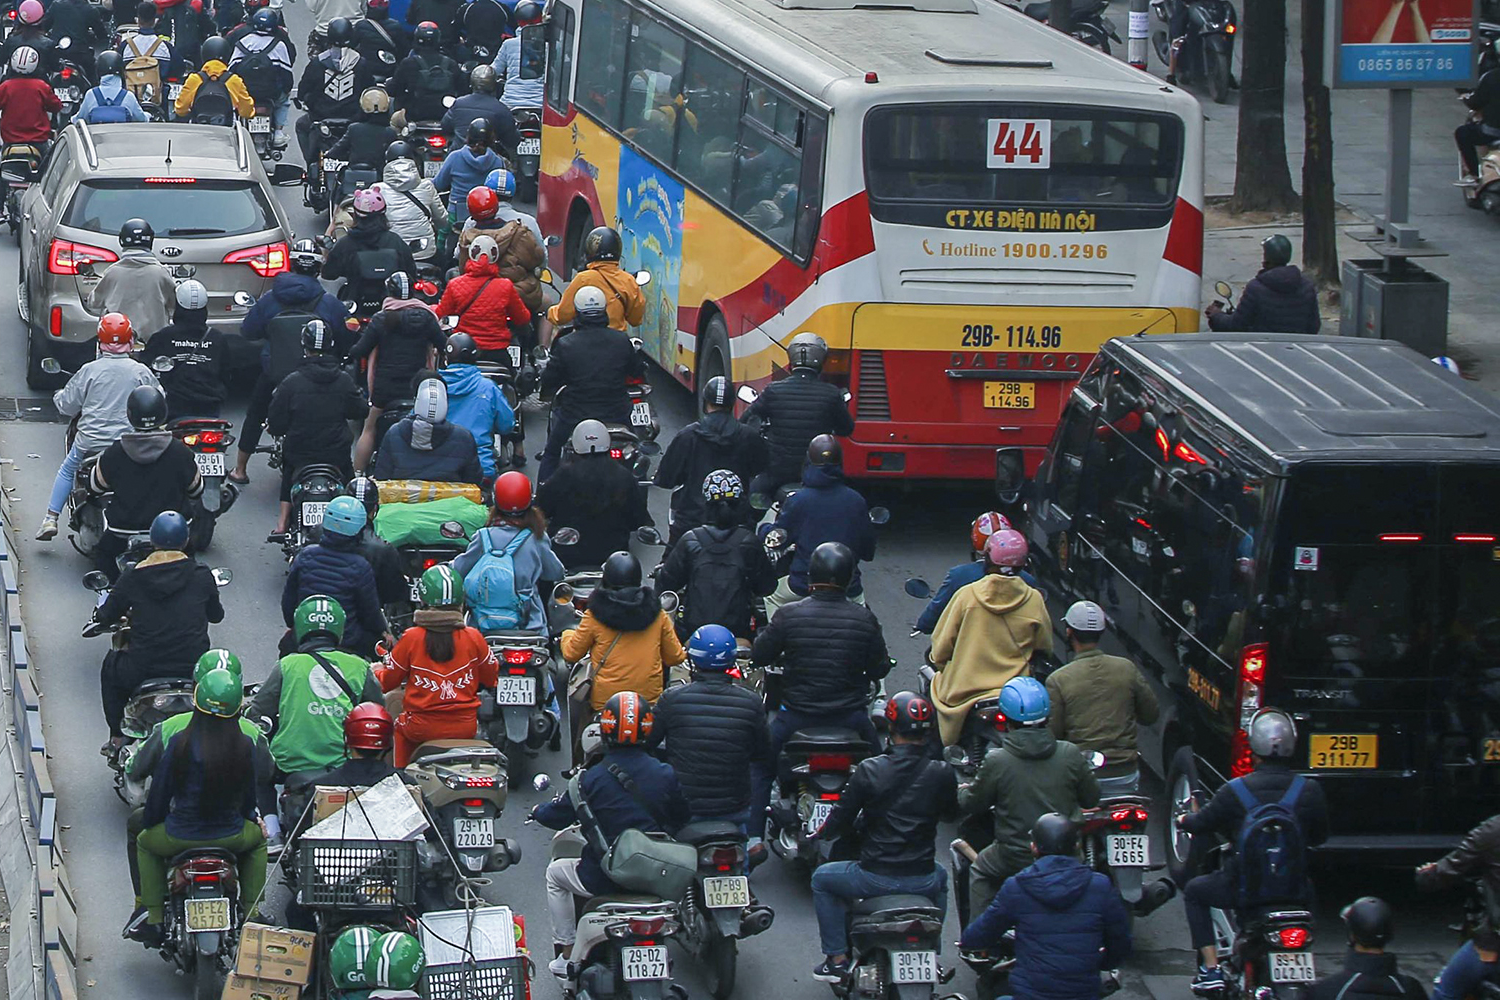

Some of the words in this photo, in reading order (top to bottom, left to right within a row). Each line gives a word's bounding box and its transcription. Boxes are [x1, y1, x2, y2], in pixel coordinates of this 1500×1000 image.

[1358, 59, 1393, 71] 0865
[1396, 59, 1412, 71] 86
[1416, 59, 1433, 70] 87
[1436, 58, 1453, 70] 86
[993, 122, 1043, 163] 44
[946, 210, 969, 227] CT
[973, 211, 993, 228] XE
[997, 208, 1034, 232] ĐIỆN
[1039, 209, 1061, 229] HÀ
[1065, 210, 1095, 234] NỘI
[940, 242, 996, 258] Hotline
[1002, 243, 1108, 259] 1900.1296
[962, 324, 1000, 347] 29B-
[1006, 325, 1061, 348] 114.96
[951, 353, 1080, 369] DAEWOO
[998, 383, 1021, 395] 29B
[990, 396, 1030, 408] 114.96
[197, 454, 219, 464] 29-G1
[200, 465, 222, 475] 95.51
[308, 611, 335, 623] Grab
[503, 680, 529, 691] 37-L1
[500, 691, 532, 704] 625.11
[1293, 689, 1352, 699] TRANSIT
[308, 701, 345, 717] Grab
[1329, 736, 1358, 750] 29B
[1317, 753, 1369, 767] 311.77
[460, 821, 488, 833] 29-Y1
[457, 834, 493, 846] 220.29
[1114, 838, 1142, 850] 30-F4
[1114, 851, 1144, 863] 4665
[711, 879, 741, 891] 17-B9
[709, 892, 746, 905] 197.83
[192, 902, 223, 914] 18-E2
[192, 915, 224, 928] 3579
[629, 949, 660, 963] 29-D2
[898, 953, 930, 966] 30-Y4
[627, 963, 665, 978] 118.27
[899, 967, 931, 981] 8518
